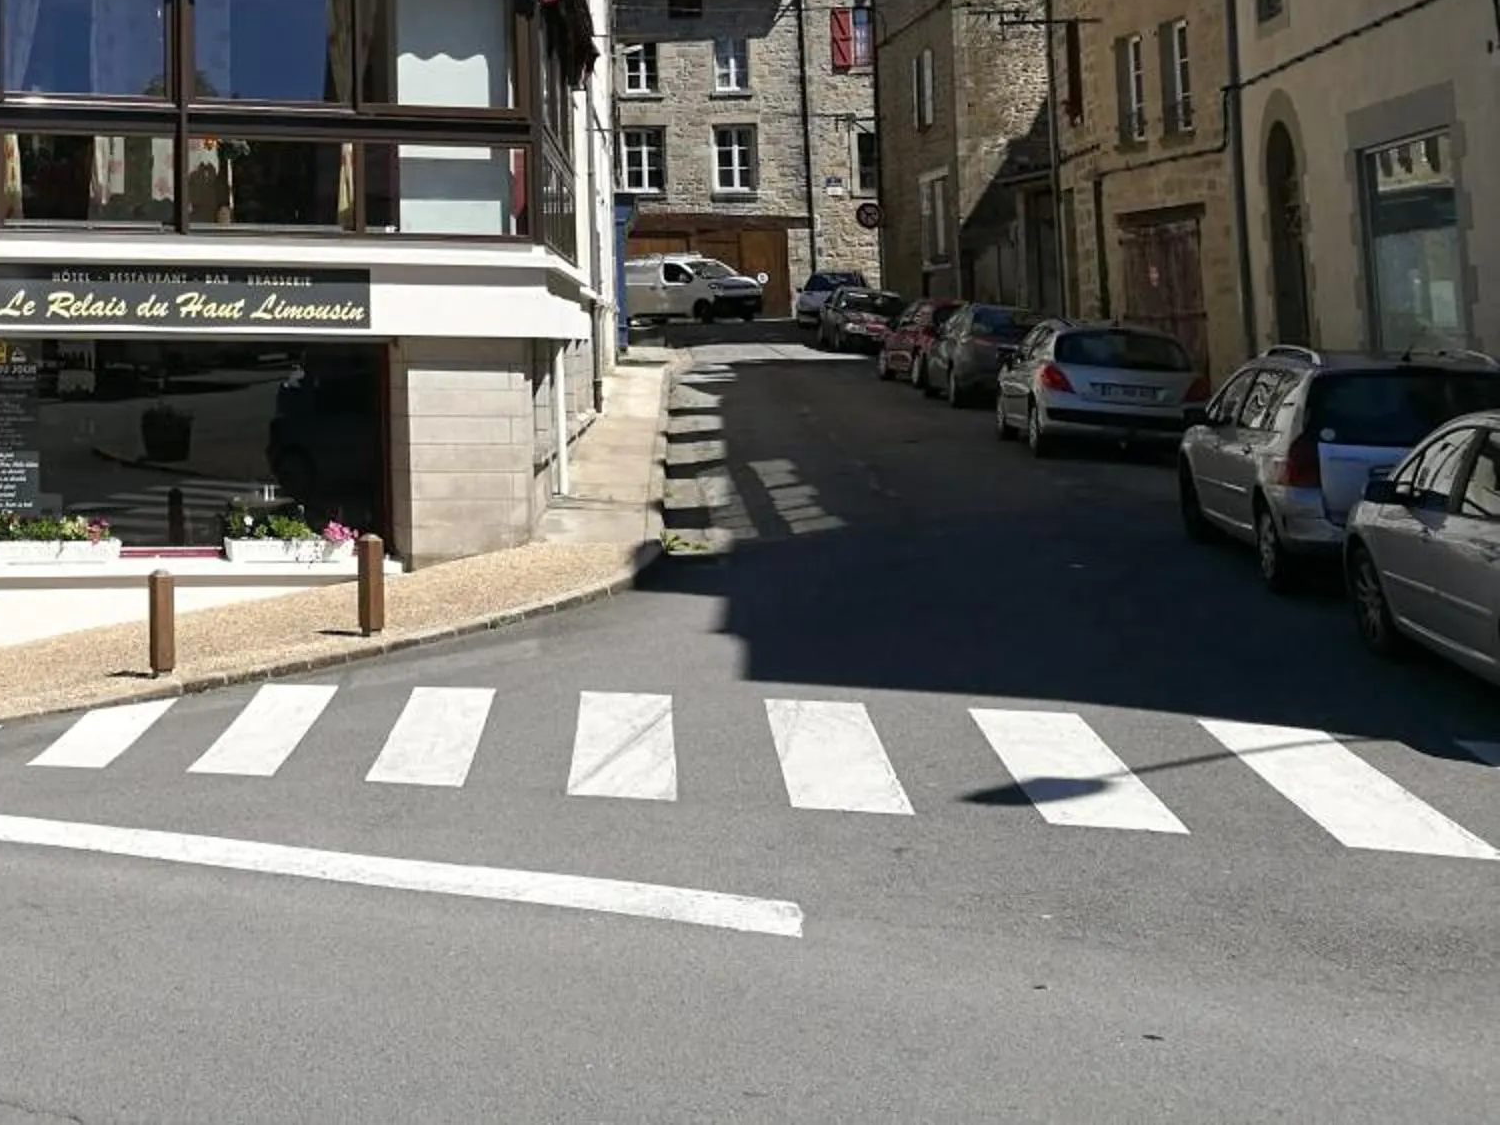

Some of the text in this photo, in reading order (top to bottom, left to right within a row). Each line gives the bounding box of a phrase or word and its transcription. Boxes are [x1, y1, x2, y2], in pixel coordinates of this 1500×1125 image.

[45, 290, 128, 318] Relais
[136, 293, 169, 318] du
[175, 291, 245, 319] Haut
[249, 293, 365, 321] Limousin
